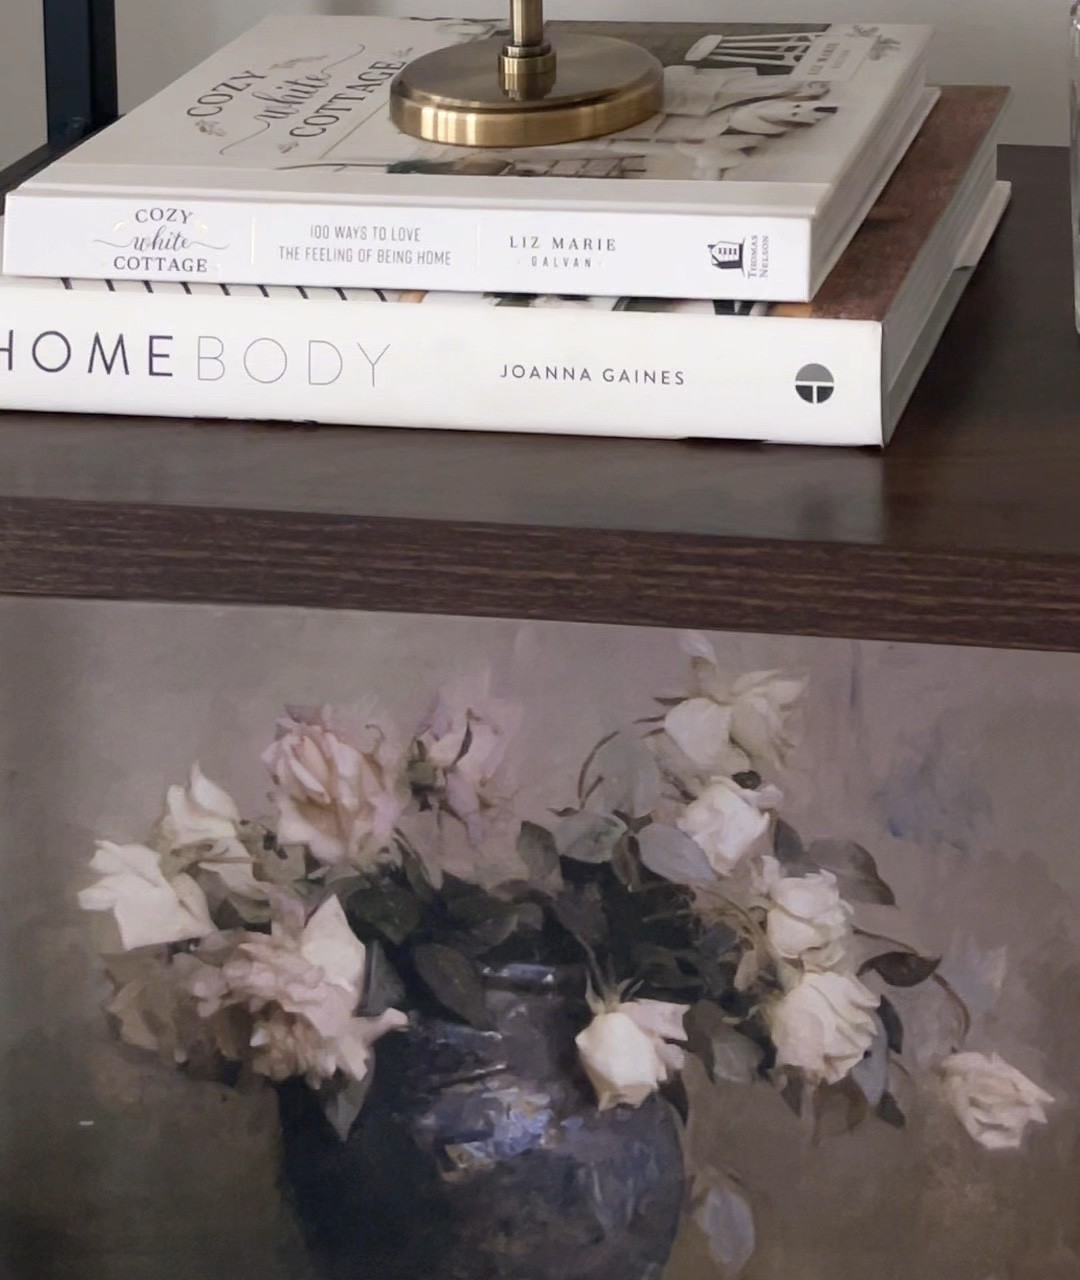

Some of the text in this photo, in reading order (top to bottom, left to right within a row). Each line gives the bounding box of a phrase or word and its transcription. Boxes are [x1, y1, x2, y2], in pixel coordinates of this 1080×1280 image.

[186, 70, 268, 117] COZY
[288, 60, 406, 137] COTTAGE
[134, 207, 194, 225] COZY
[310, 224, 421, 242] 100 WAYS TO LOVE
[509, 235, 616, 251] LIZ MARIE
[113, 255, 209, 273] COTTAGE
[278, 245, 452, 266] THE FEELING OF BEING HOME
[531, 255, 592, 268] GALVAN
[747, 234, 758, 280] THOMAS
[758, 234, 769, 279] NELSON
[500, 364, 686, 386] JOANNA GAINES
